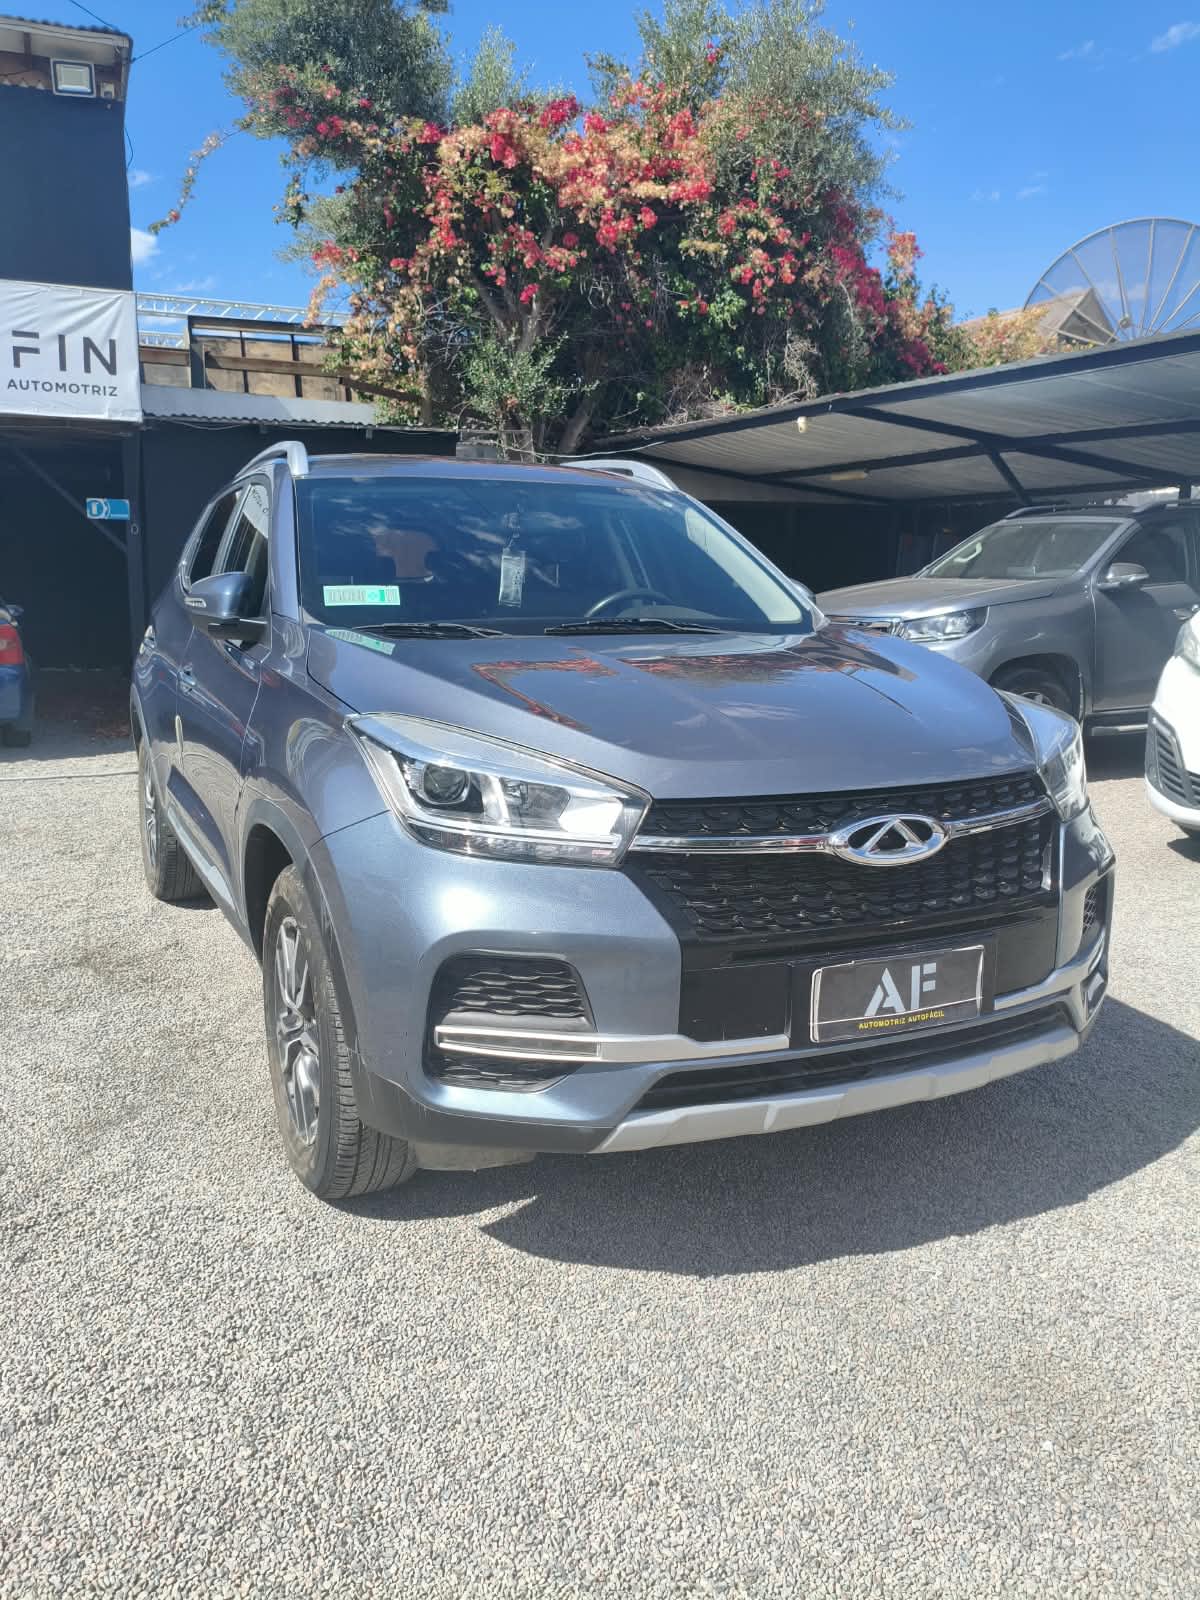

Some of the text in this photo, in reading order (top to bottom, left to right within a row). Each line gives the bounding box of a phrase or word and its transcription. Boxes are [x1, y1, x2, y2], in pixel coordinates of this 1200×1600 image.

[7, 379, 118, 397] AUTOMOTRIZ
[864, 962, 937, 1017] AF
[858, 1010, 944, 1029] AUTOMOTRIZ AUTOFÁCIL
